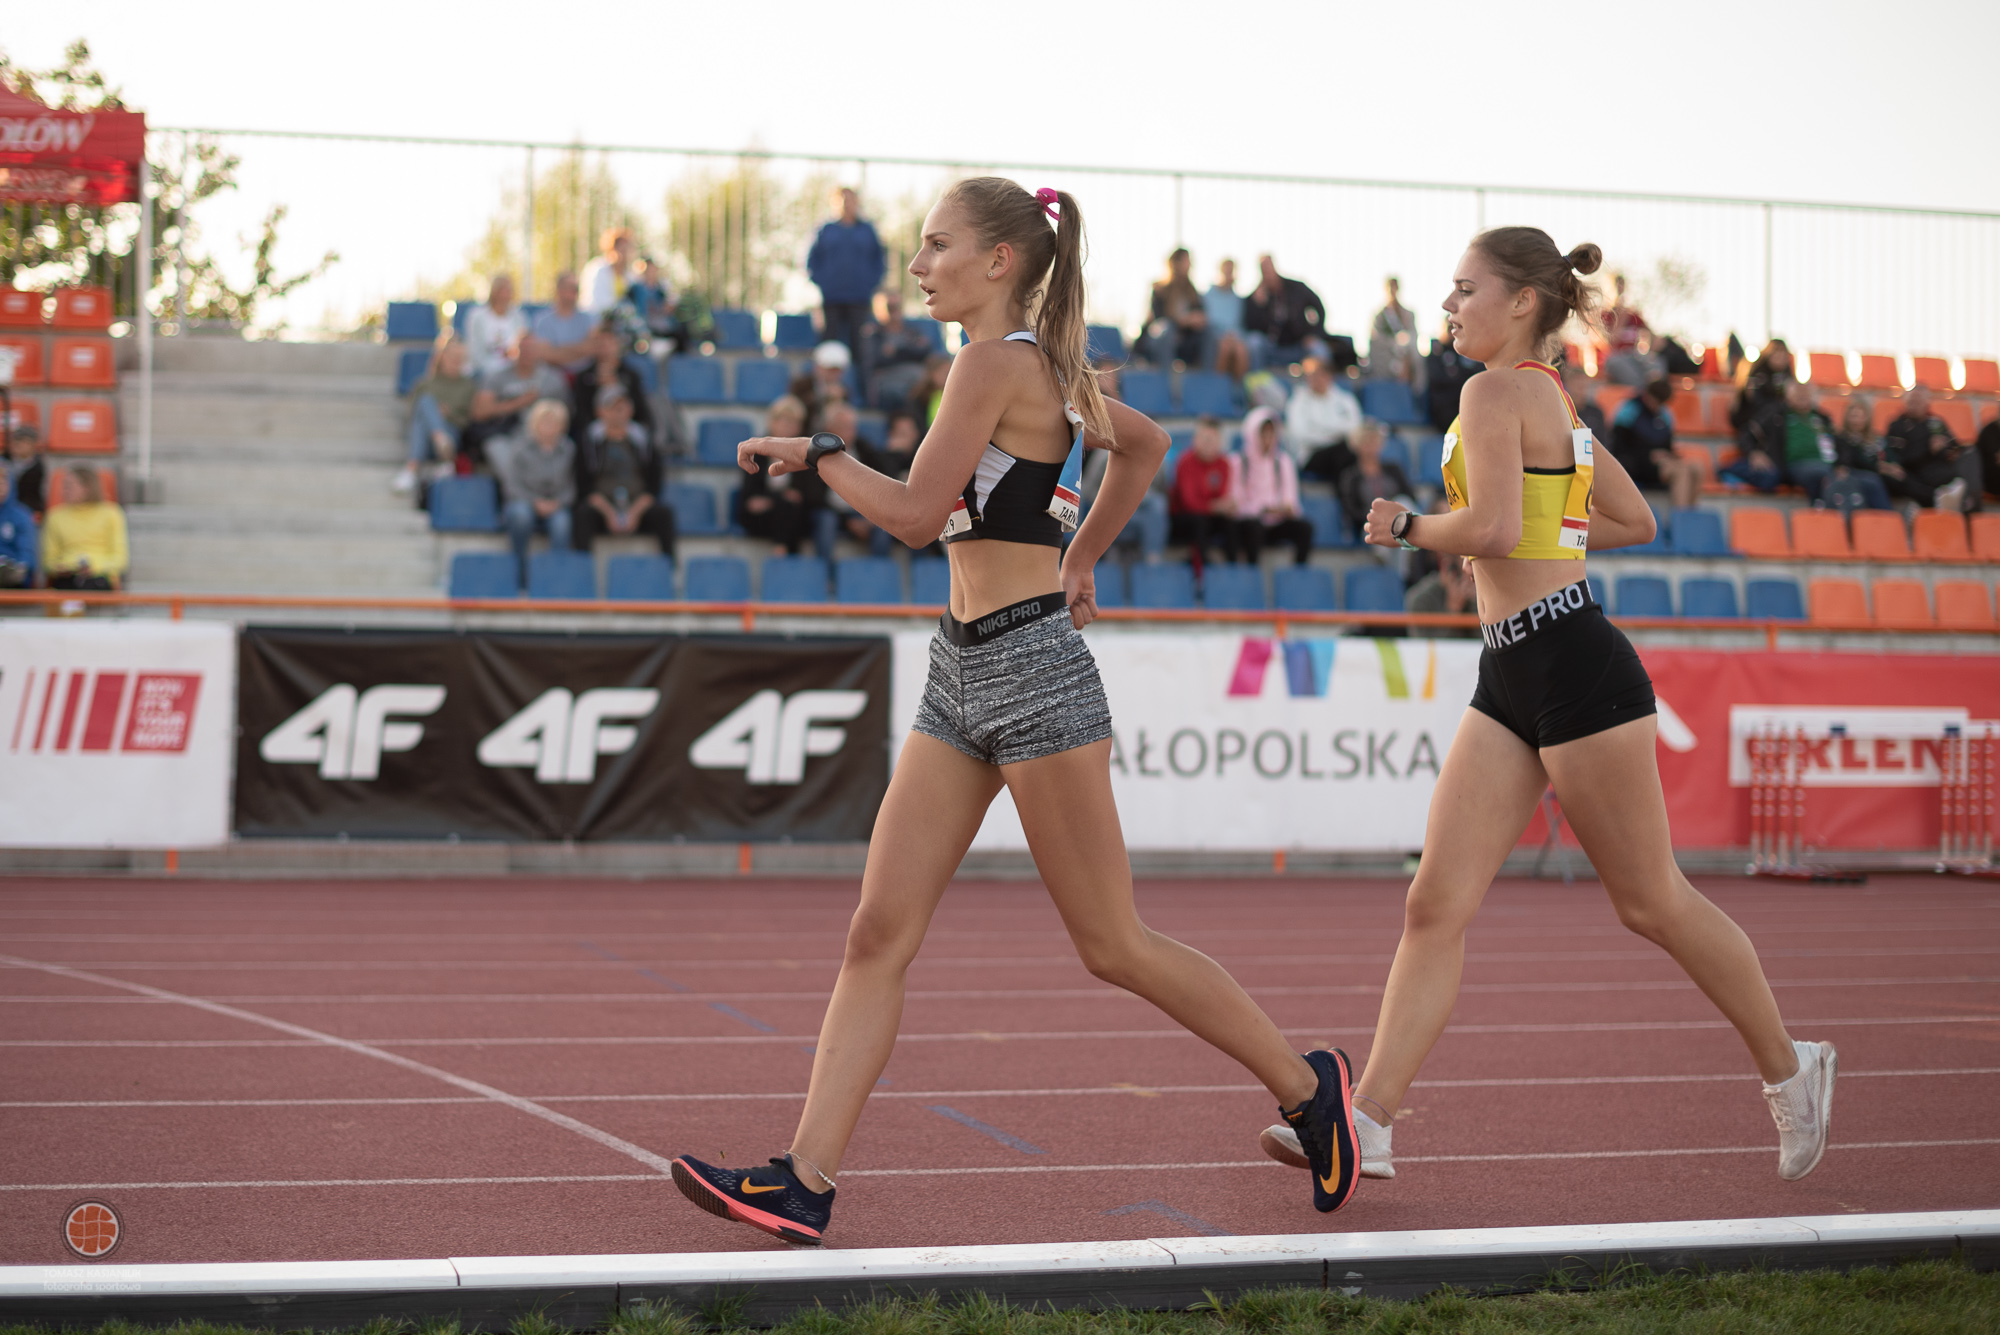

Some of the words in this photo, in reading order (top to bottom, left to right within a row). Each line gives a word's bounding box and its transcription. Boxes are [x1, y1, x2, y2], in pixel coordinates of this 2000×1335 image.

[977, 612, 1009, 636] NIKE
[1011, 601, 1042, 622] PRO
[1480, 611, 1527, 650] NIKE
[1528, 583, 1584, 631] PRO
[260, 683, 447, 780] 4F
[477, 687, 660, 783] 4F
[689, 689, 868, 784] 4F
